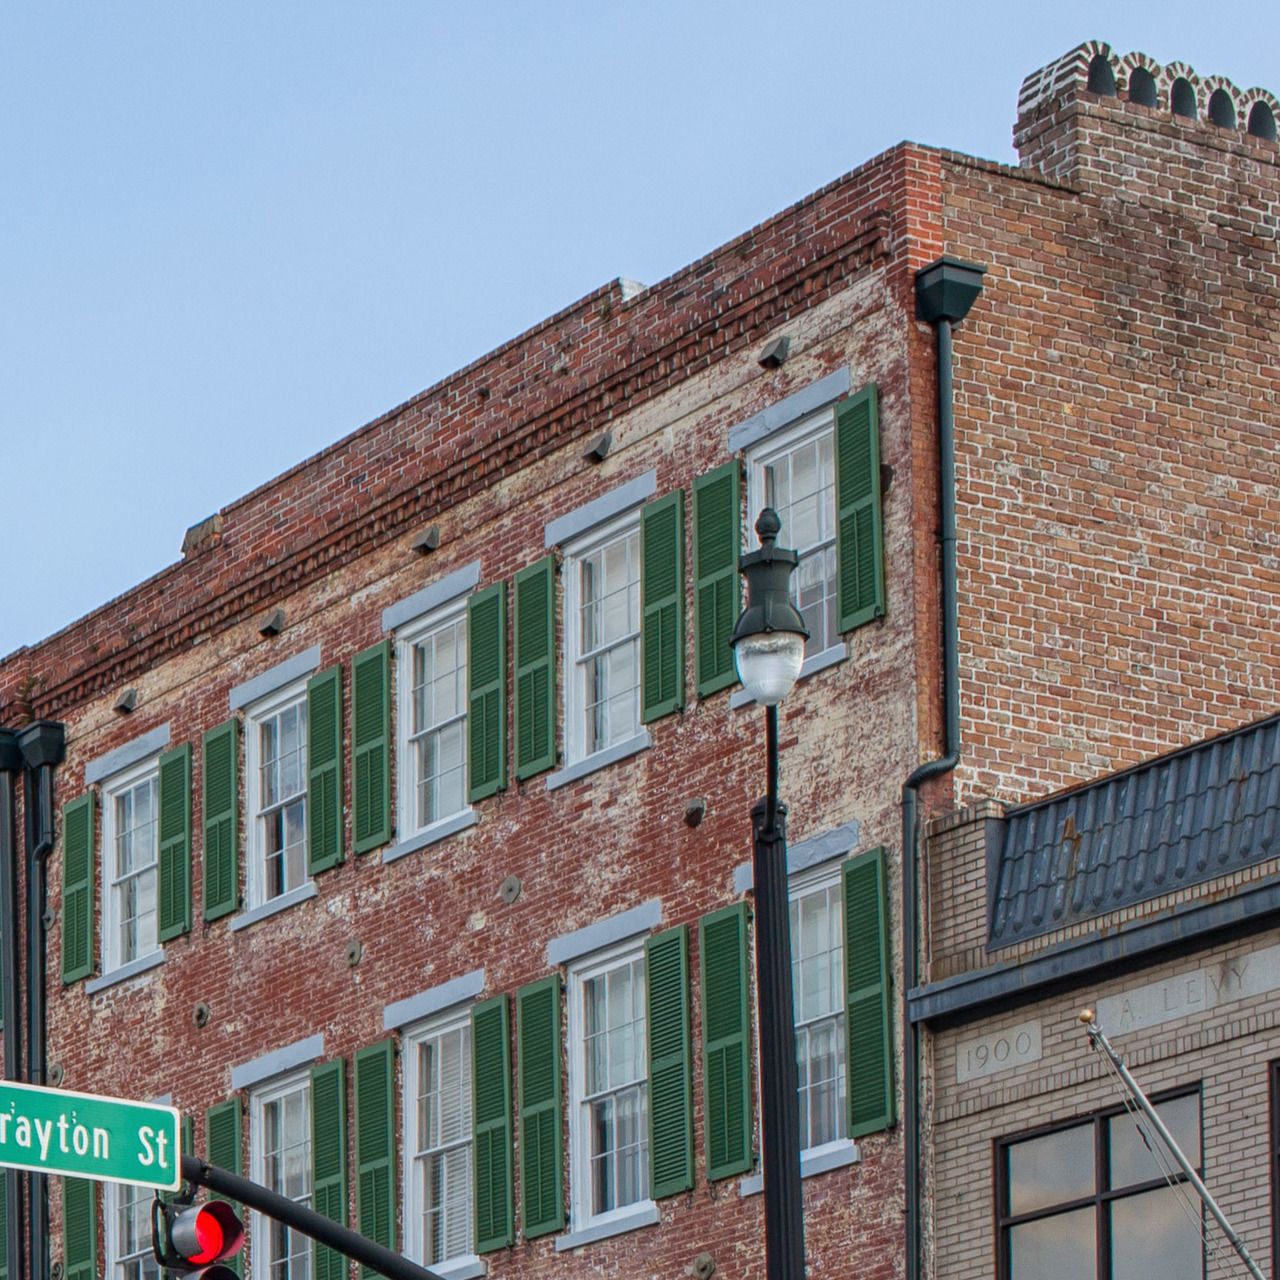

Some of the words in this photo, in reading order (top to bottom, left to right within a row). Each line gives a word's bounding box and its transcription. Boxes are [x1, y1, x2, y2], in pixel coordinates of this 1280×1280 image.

[1163, 963, 1248, 1012] LEVY
[966, 1031, 1032, 1072] 1900
[138, 1126, 169, 1168] St
